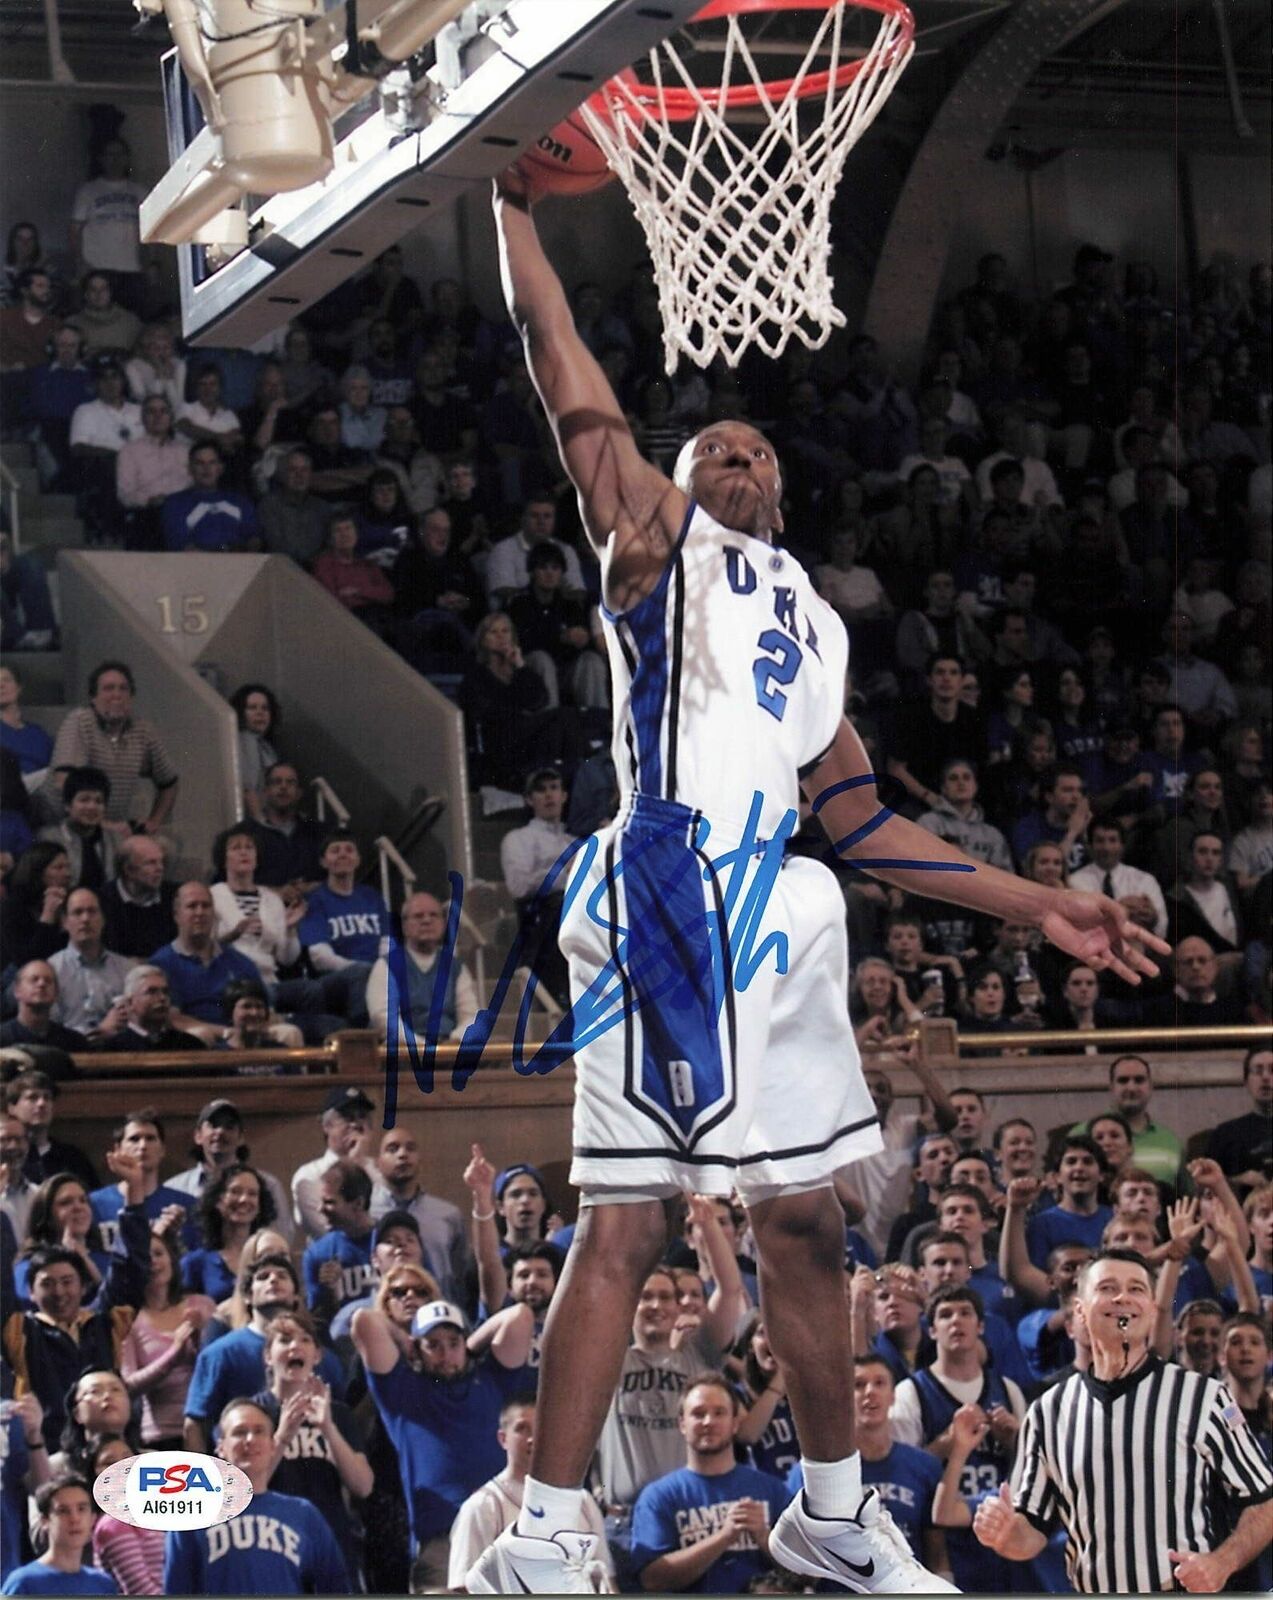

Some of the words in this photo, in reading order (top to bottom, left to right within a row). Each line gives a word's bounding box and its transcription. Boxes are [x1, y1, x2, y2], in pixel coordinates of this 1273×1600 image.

[155, 595, 209, 633] 15
[752, 628, 803, 722] 2
[206, 1514, 300, 1568] DUKE
